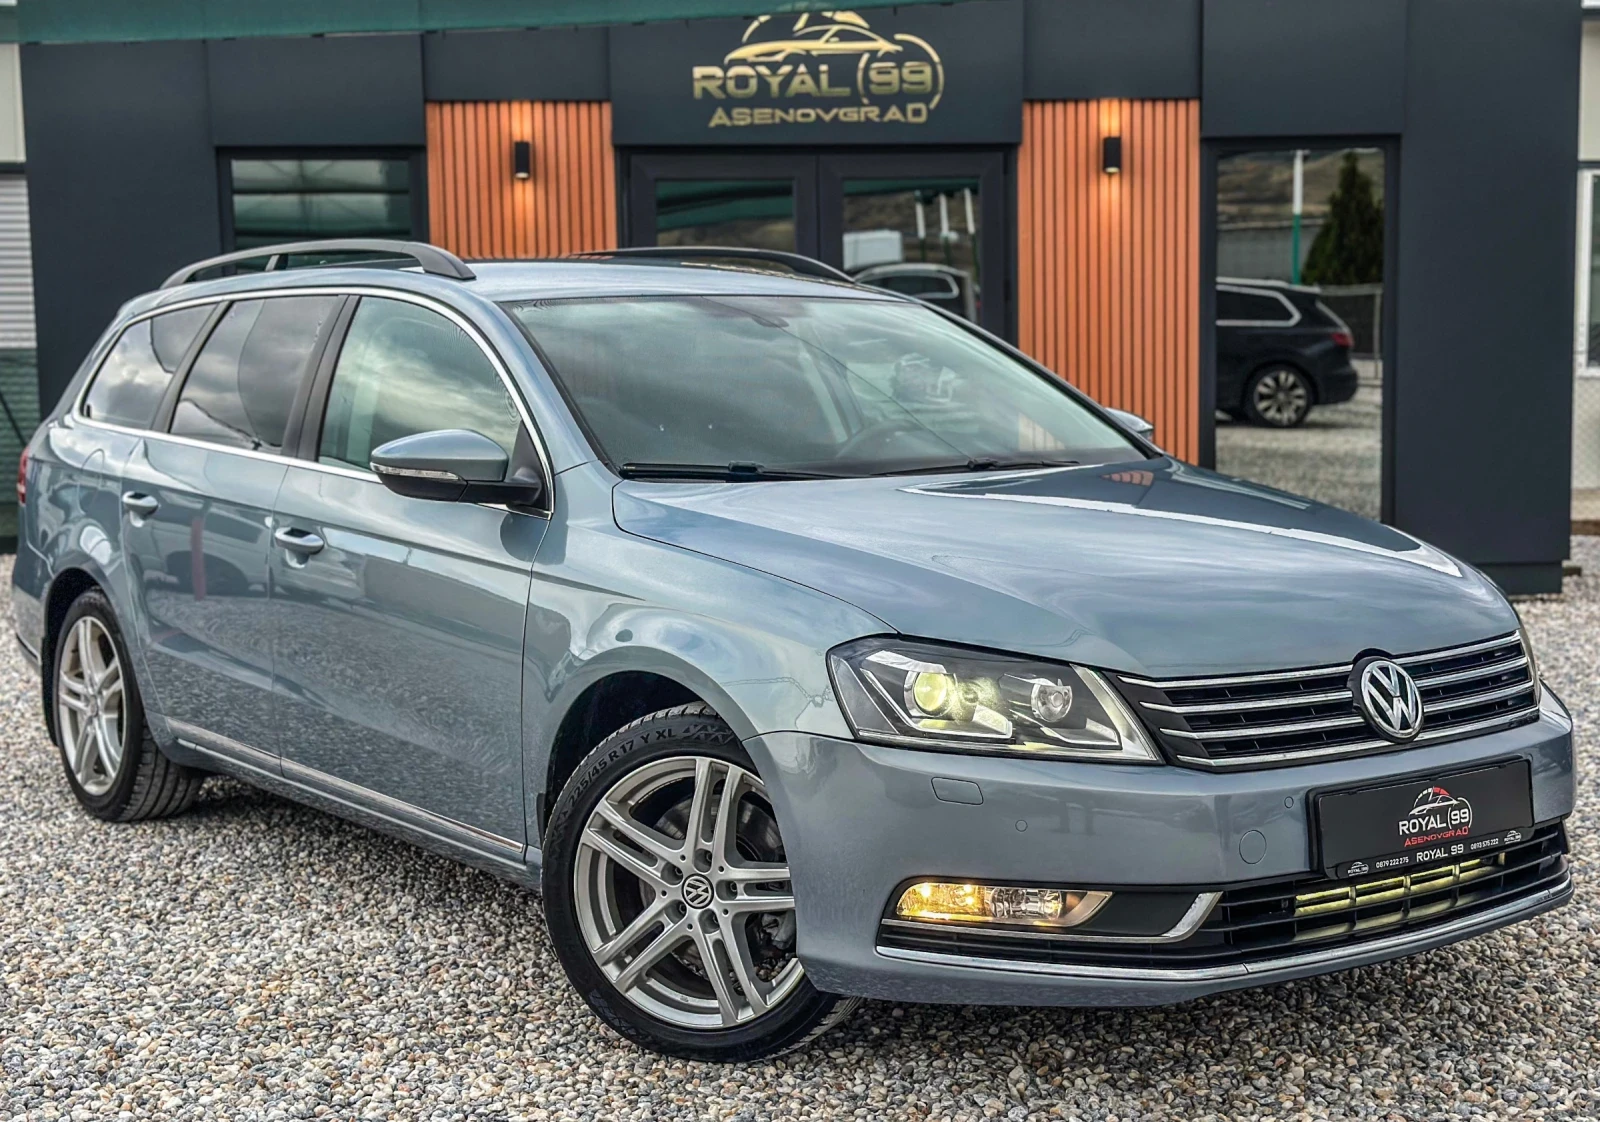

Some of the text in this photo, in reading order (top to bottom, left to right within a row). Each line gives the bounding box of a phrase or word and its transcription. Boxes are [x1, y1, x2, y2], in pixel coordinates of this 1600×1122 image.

[692, 63, 851, 99] ROYAL
[708, 102, 928, 128] ASENOVGRAD
[569, 758, 608, 807] 225/45
[640, 733, 650, 744] Y
[656, 728, 677, 740] XL
[1398, 814, 1447, 836] ROYAL
[1404, 826, 1469, 847] ASENOVGRAD
[1375, 856, 1410, 868] 0879 222 275
[1416, 843, 1464, 862] ROYAL 99
